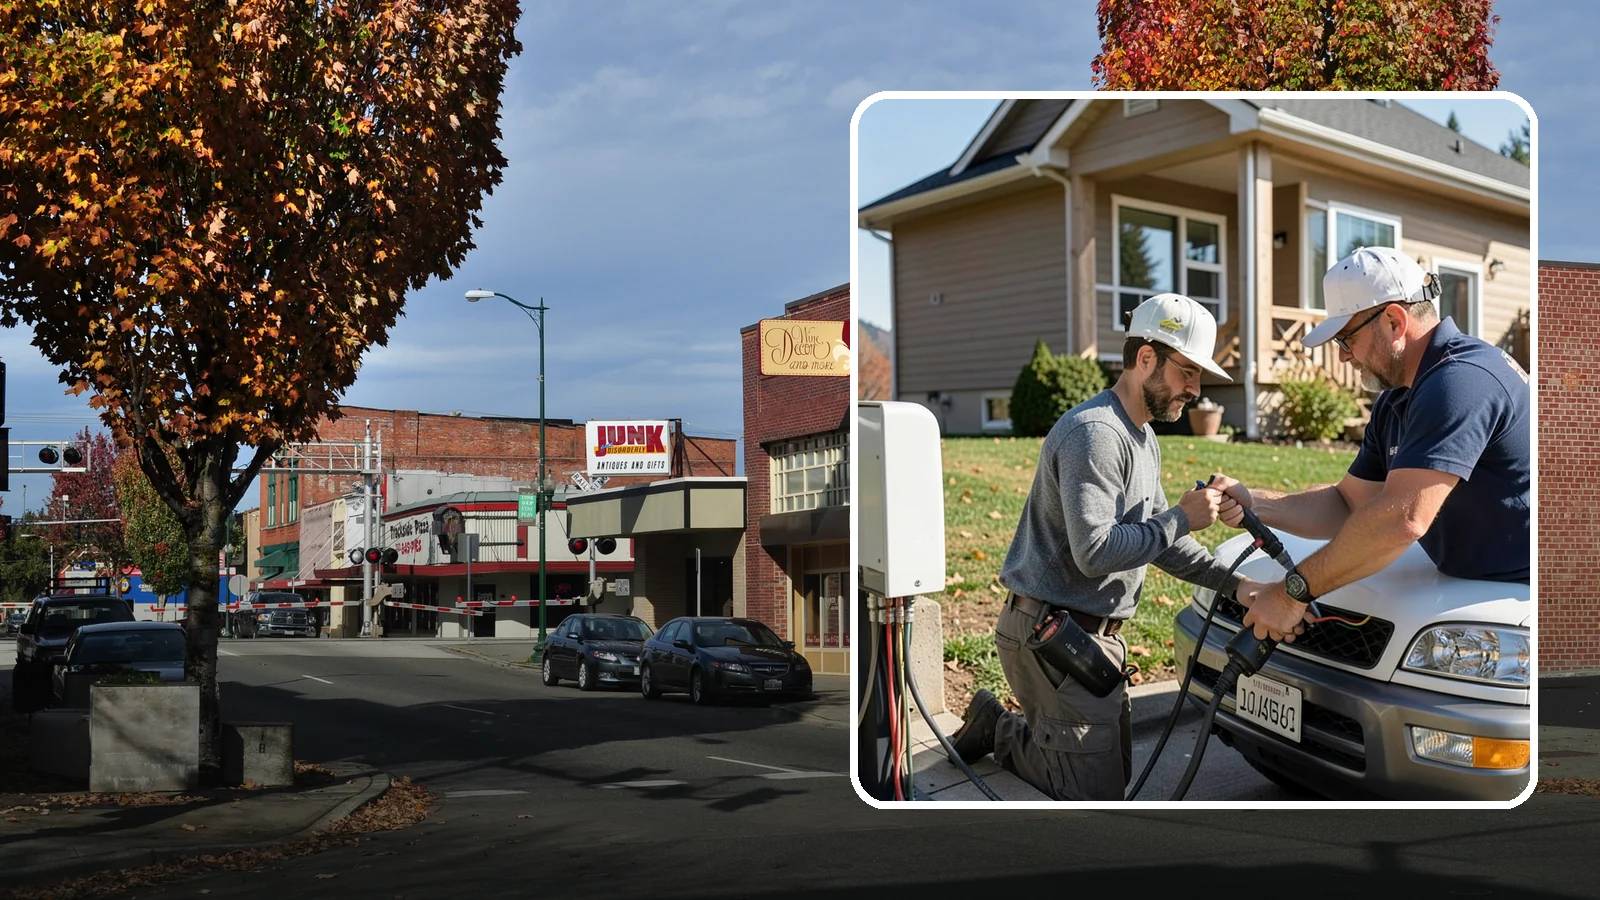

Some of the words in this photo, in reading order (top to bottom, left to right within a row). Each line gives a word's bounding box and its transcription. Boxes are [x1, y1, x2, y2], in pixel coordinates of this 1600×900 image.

[596, 425, 666, 457] JUNK
[607, 446, 646, 454] DISORDERLY
[597, 461, 628, 470] ANTIQUES
[631, 461, 644, 470] AND
[647, 460, 665, 469] GIFTS
[390, 521, 413, 539] Trackside
[415, 519, 429, 535] Pizza
